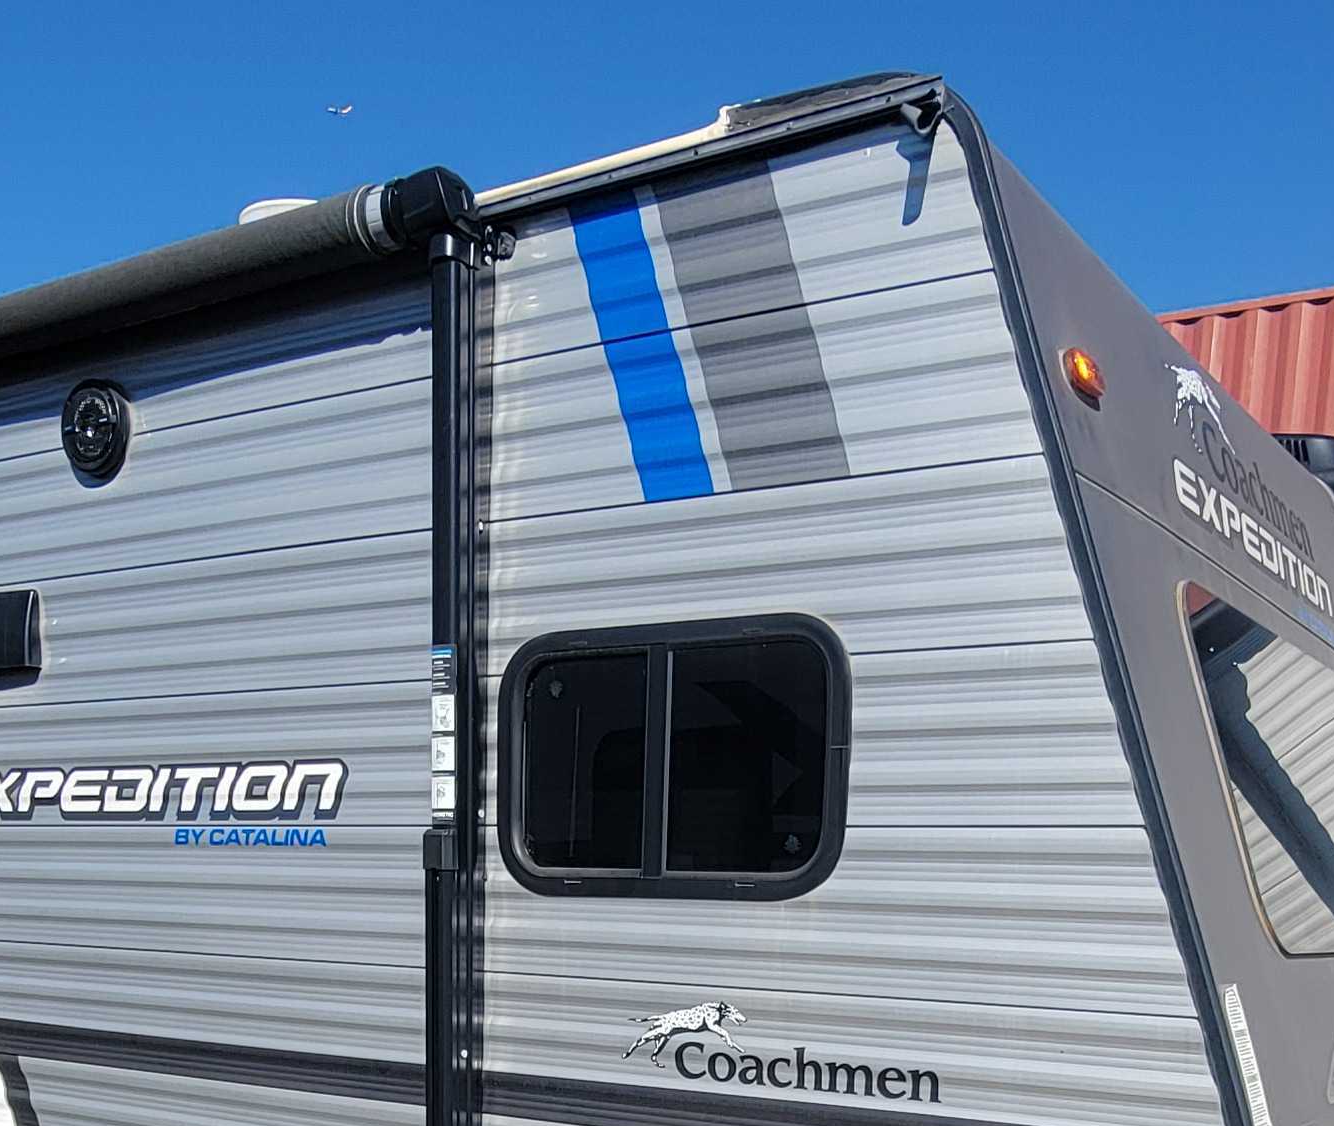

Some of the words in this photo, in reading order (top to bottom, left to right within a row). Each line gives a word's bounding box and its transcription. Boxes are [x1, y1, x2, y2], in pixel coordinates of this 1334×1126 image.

[1173, 458, 1334, 618] EXPEDITION
[1201, 420, 1316, 563] Coachmen
[174, 829, 206, 846] BY
[208, 828, 327, 847] CATALINA
[674, 1041, 942, 1103] Coachmen
